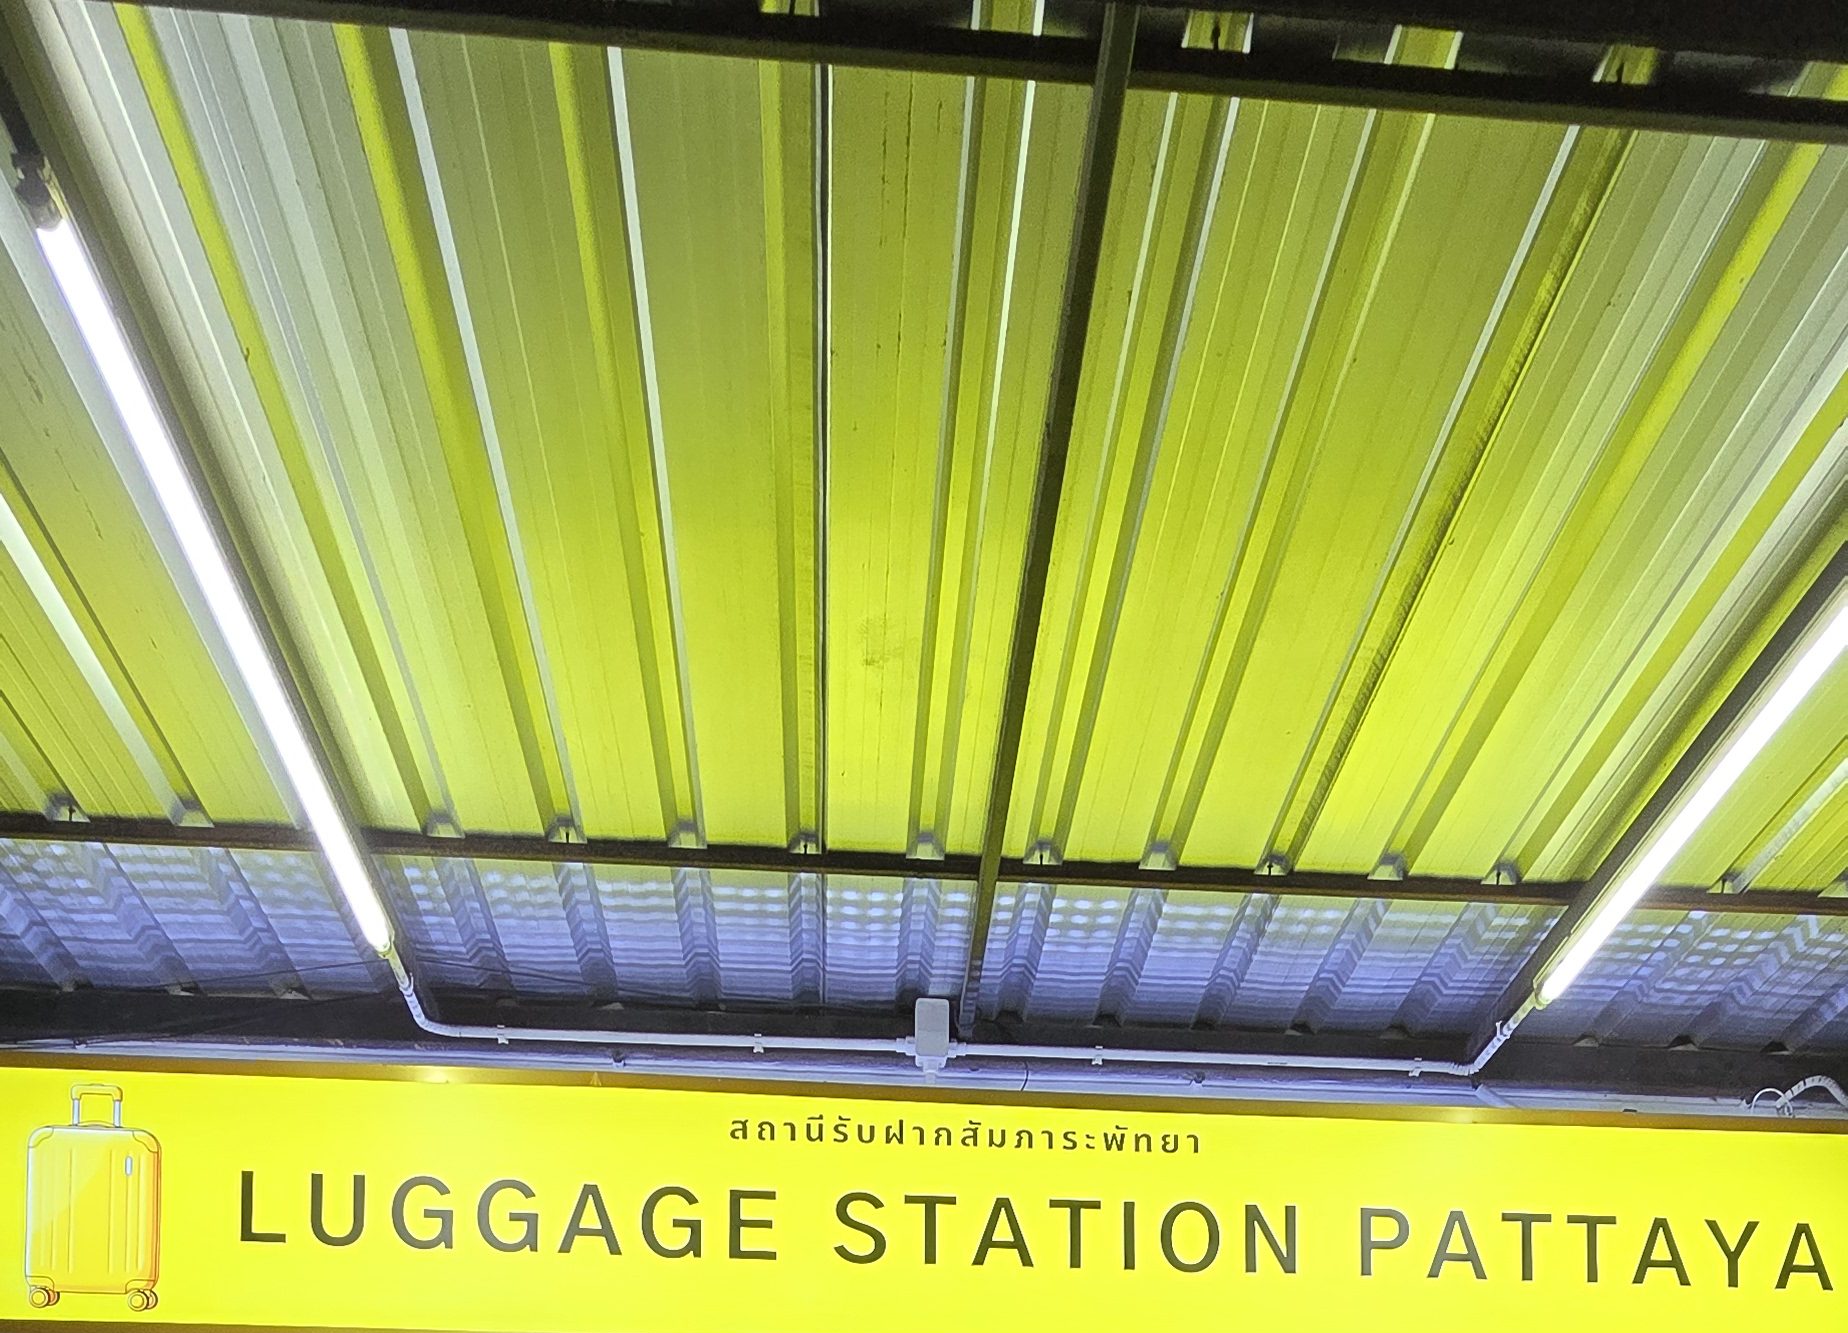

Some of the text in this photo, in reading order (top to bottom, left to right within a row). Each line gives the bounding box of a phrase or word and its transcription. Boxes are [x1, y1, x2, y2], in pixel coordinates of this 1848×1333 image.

[729, 1113, 1201, 1155] สถานีรับฝากสัมภาระพัทยา
[239, 1169, 1835, 1292] LUGGAGE STATION PATTAYA
